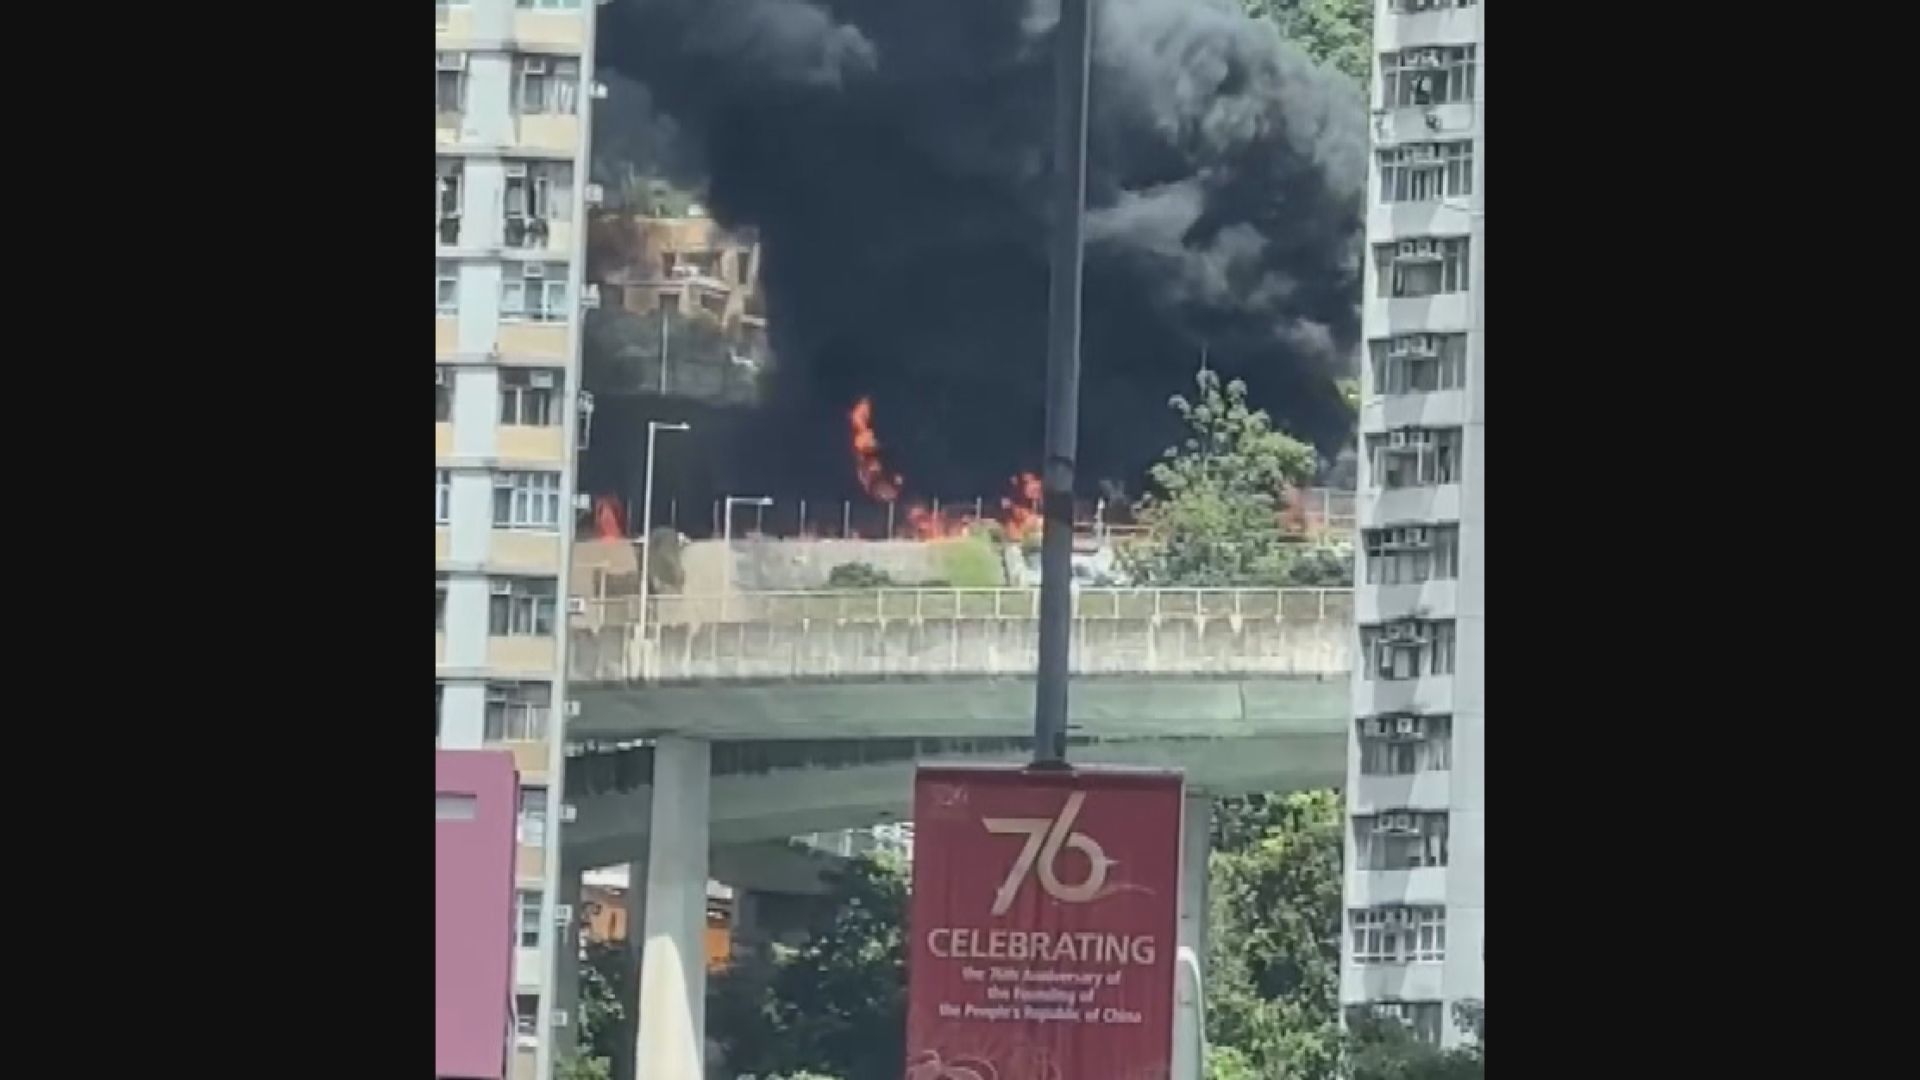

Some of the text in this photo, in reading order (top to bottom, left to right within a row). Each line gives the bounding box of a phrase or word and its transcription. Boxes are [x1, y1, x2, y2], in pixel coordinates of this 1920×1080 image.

[982, 790, 1108, 916] 76
[927, 928, 1155, 964] CELEBRATING
[962, 966, 985, 981] the
[1105, 969, 1121, 985] of
[987, 984, 1010, 1000] the
[1079, 988, 1095, 1003] of
[938, 1002, 961, 1017] the
[964, 1002, 1020, 1022] People's
[1085, 1007, 1100, 1021] of
[1103, 1008, 1142, 1024] China
